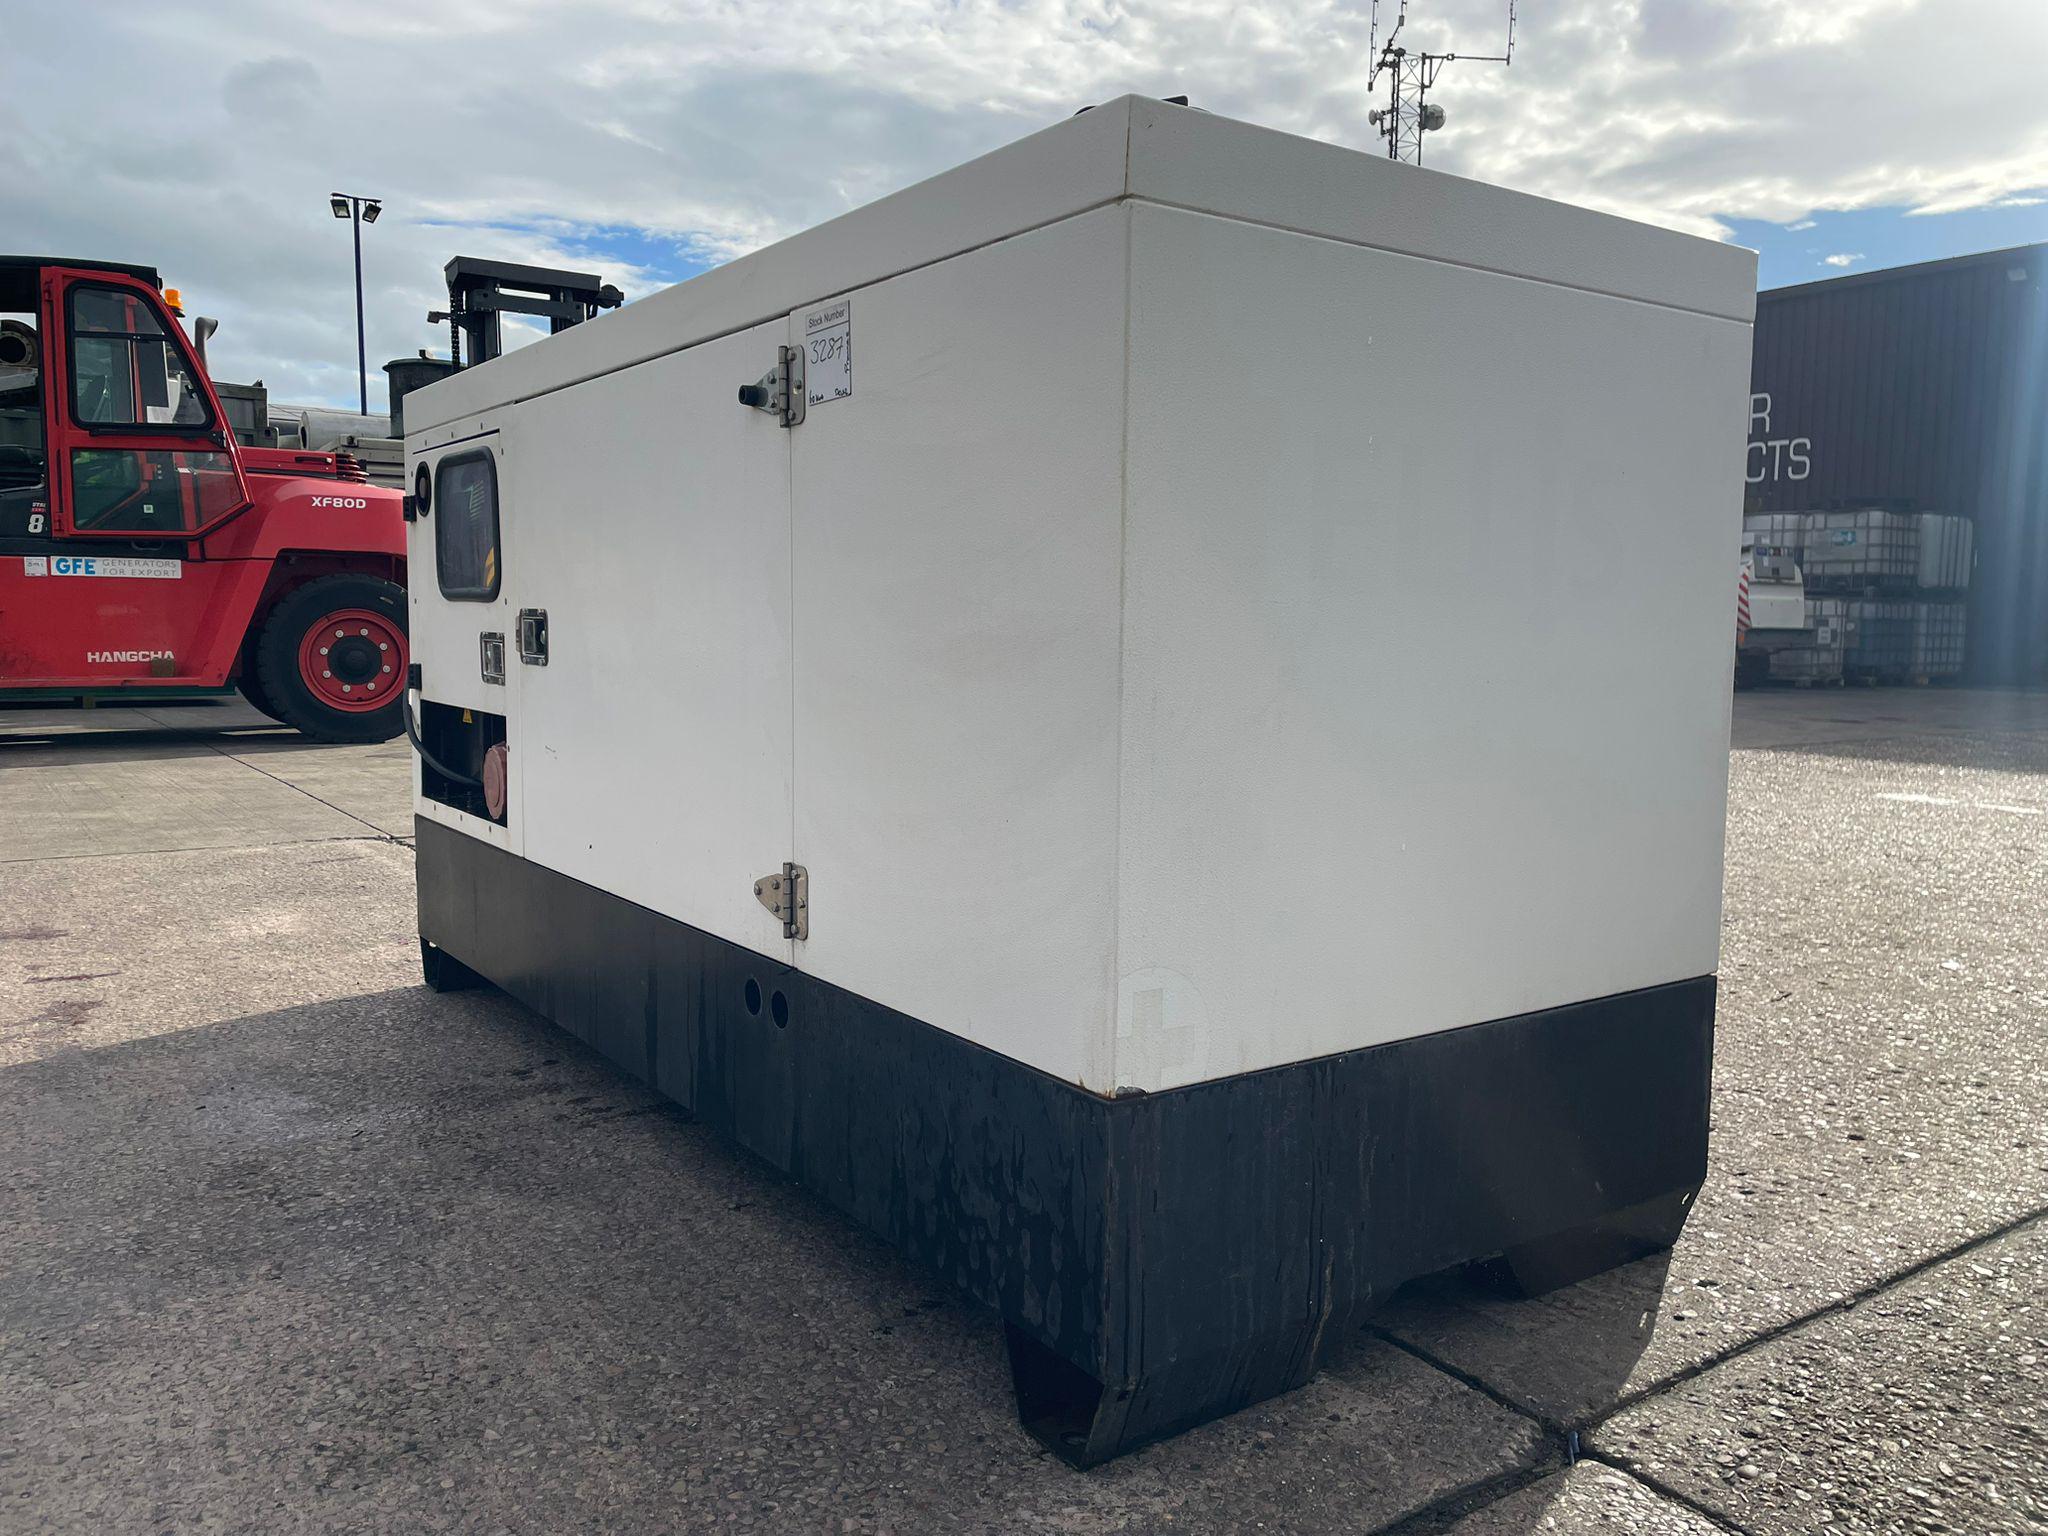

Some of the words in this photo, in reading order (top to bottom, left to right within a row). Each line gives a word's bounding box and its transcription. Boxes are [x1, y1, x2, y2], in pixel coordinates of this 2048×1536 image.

[808, 316, 823, 329] Stock
[824, 308, 846, 324] Number
[810, 335, 844, 365] 3287
[311, 496, 366, 509] XF80D
[28, 514, 44, 533] 8
[55, 557, 96, 575] GFE
[102, 559, 176, 568] GENERATORS
[102, 568, 126, 576] FOR
[131, 568, 176, 577] EXPORT
[86, 650, 175, 663] HANGCHA
